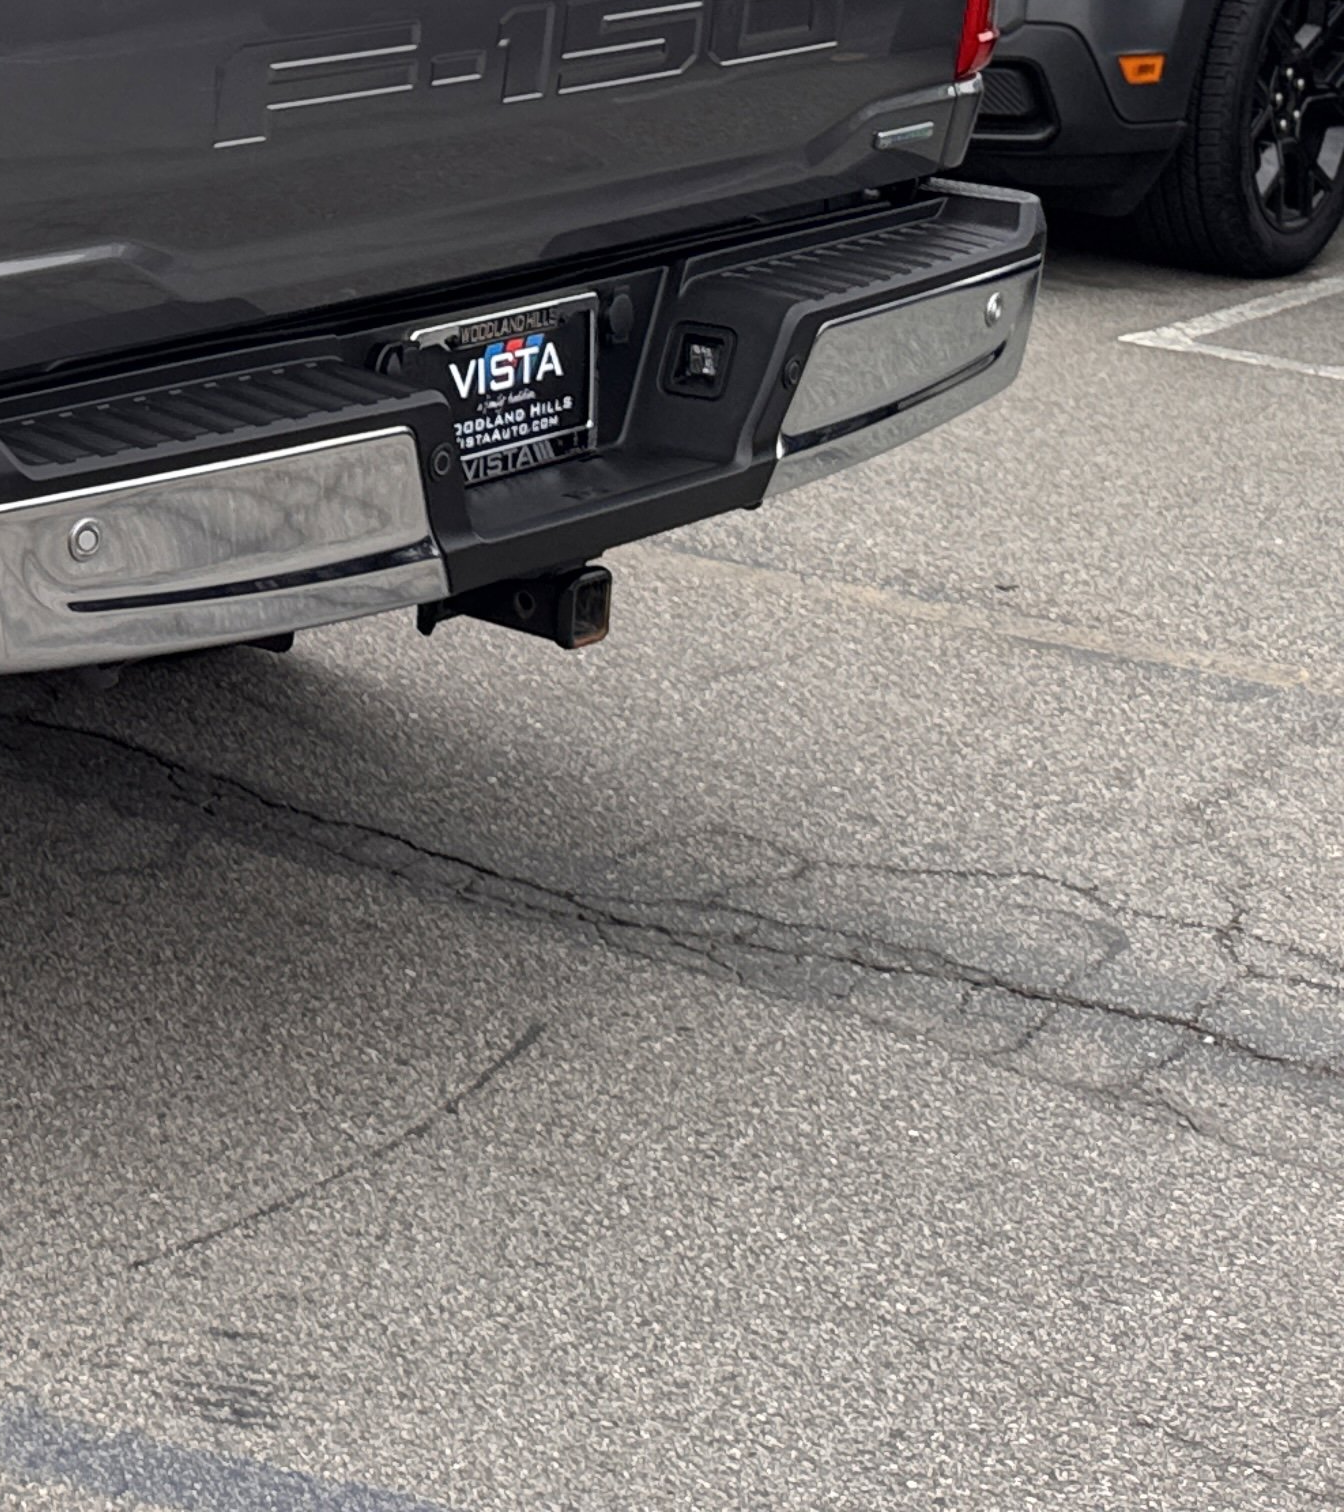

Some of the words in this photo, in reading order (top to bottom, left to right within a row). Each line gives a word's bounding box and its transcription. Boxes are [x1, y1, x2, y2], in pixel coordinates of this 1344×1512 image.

[448, 342, 564, 399] VISTA
[454, 408, 525, 436] OODLAND
[530, 396, 573, 418] HILLS
[463, 445, 537, 483] VISTA
